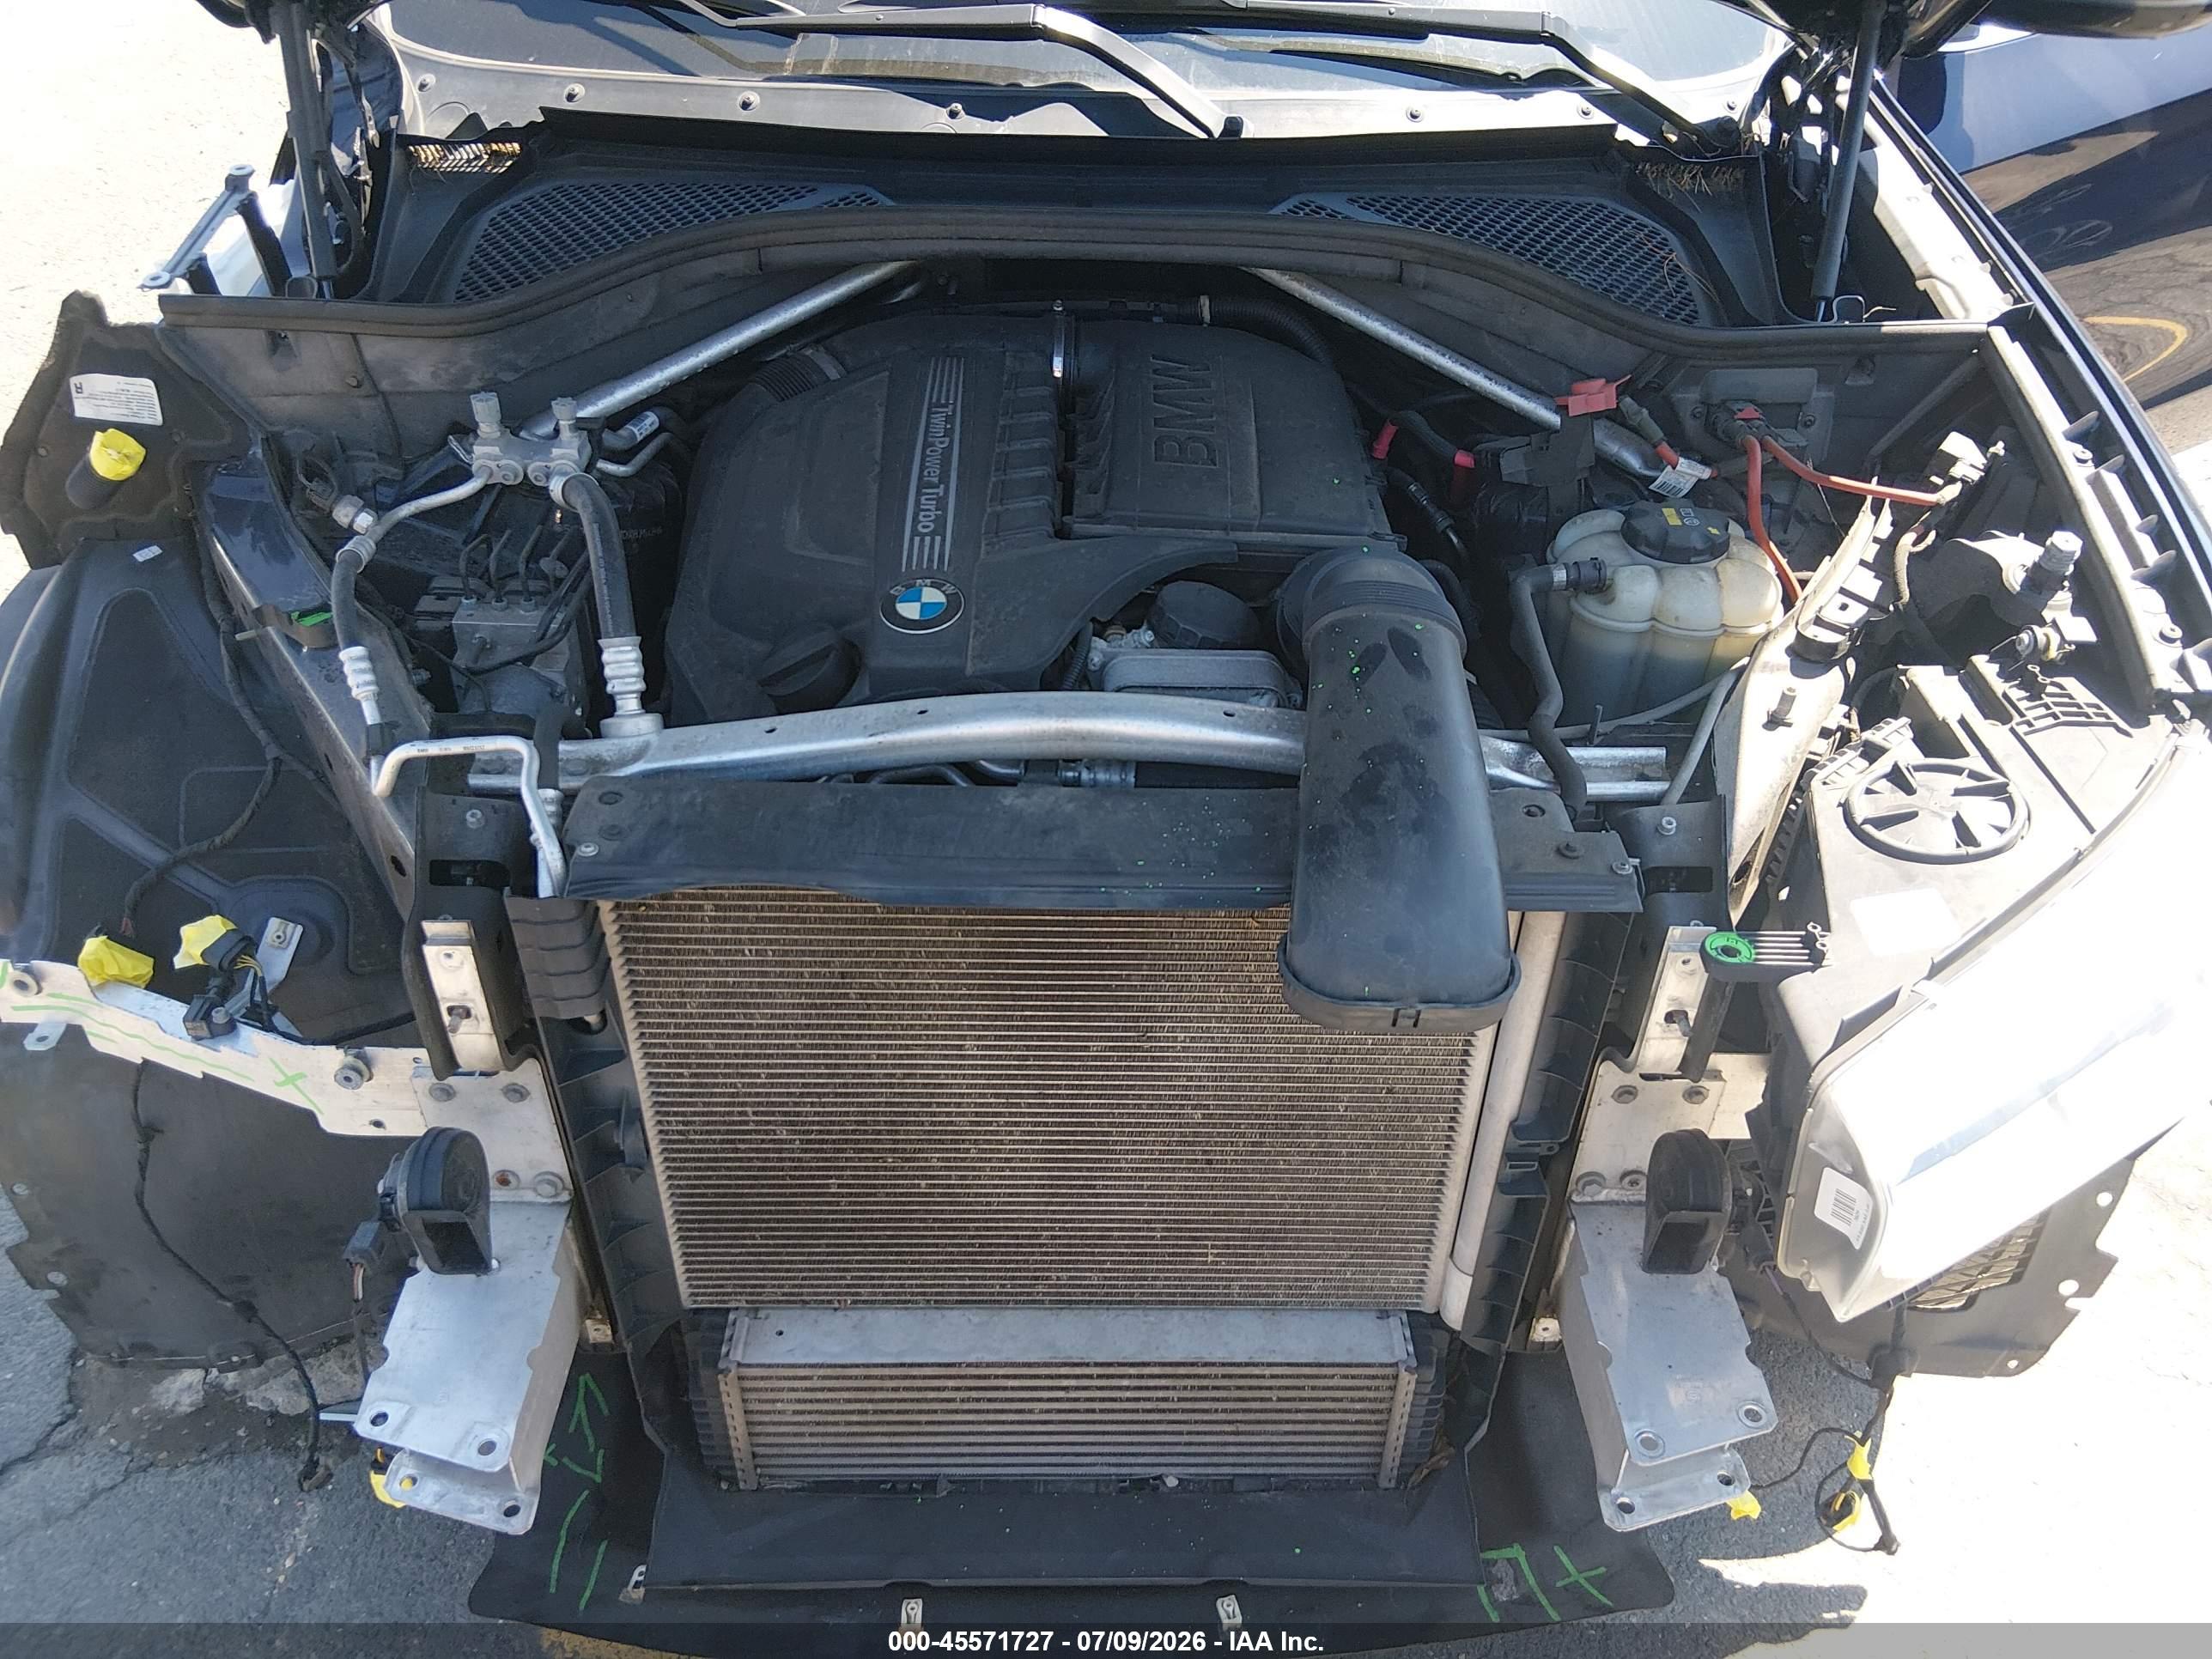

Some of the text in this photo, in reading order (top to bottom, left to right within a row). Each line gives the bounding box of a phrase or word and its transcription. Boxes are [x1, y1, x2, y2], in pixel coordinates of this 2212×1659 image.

[917, 403, 954, 532] TwinPower Turbo
[1151, 355, 1218, 468] BMW
[890, 579, 957, 596] BMW
